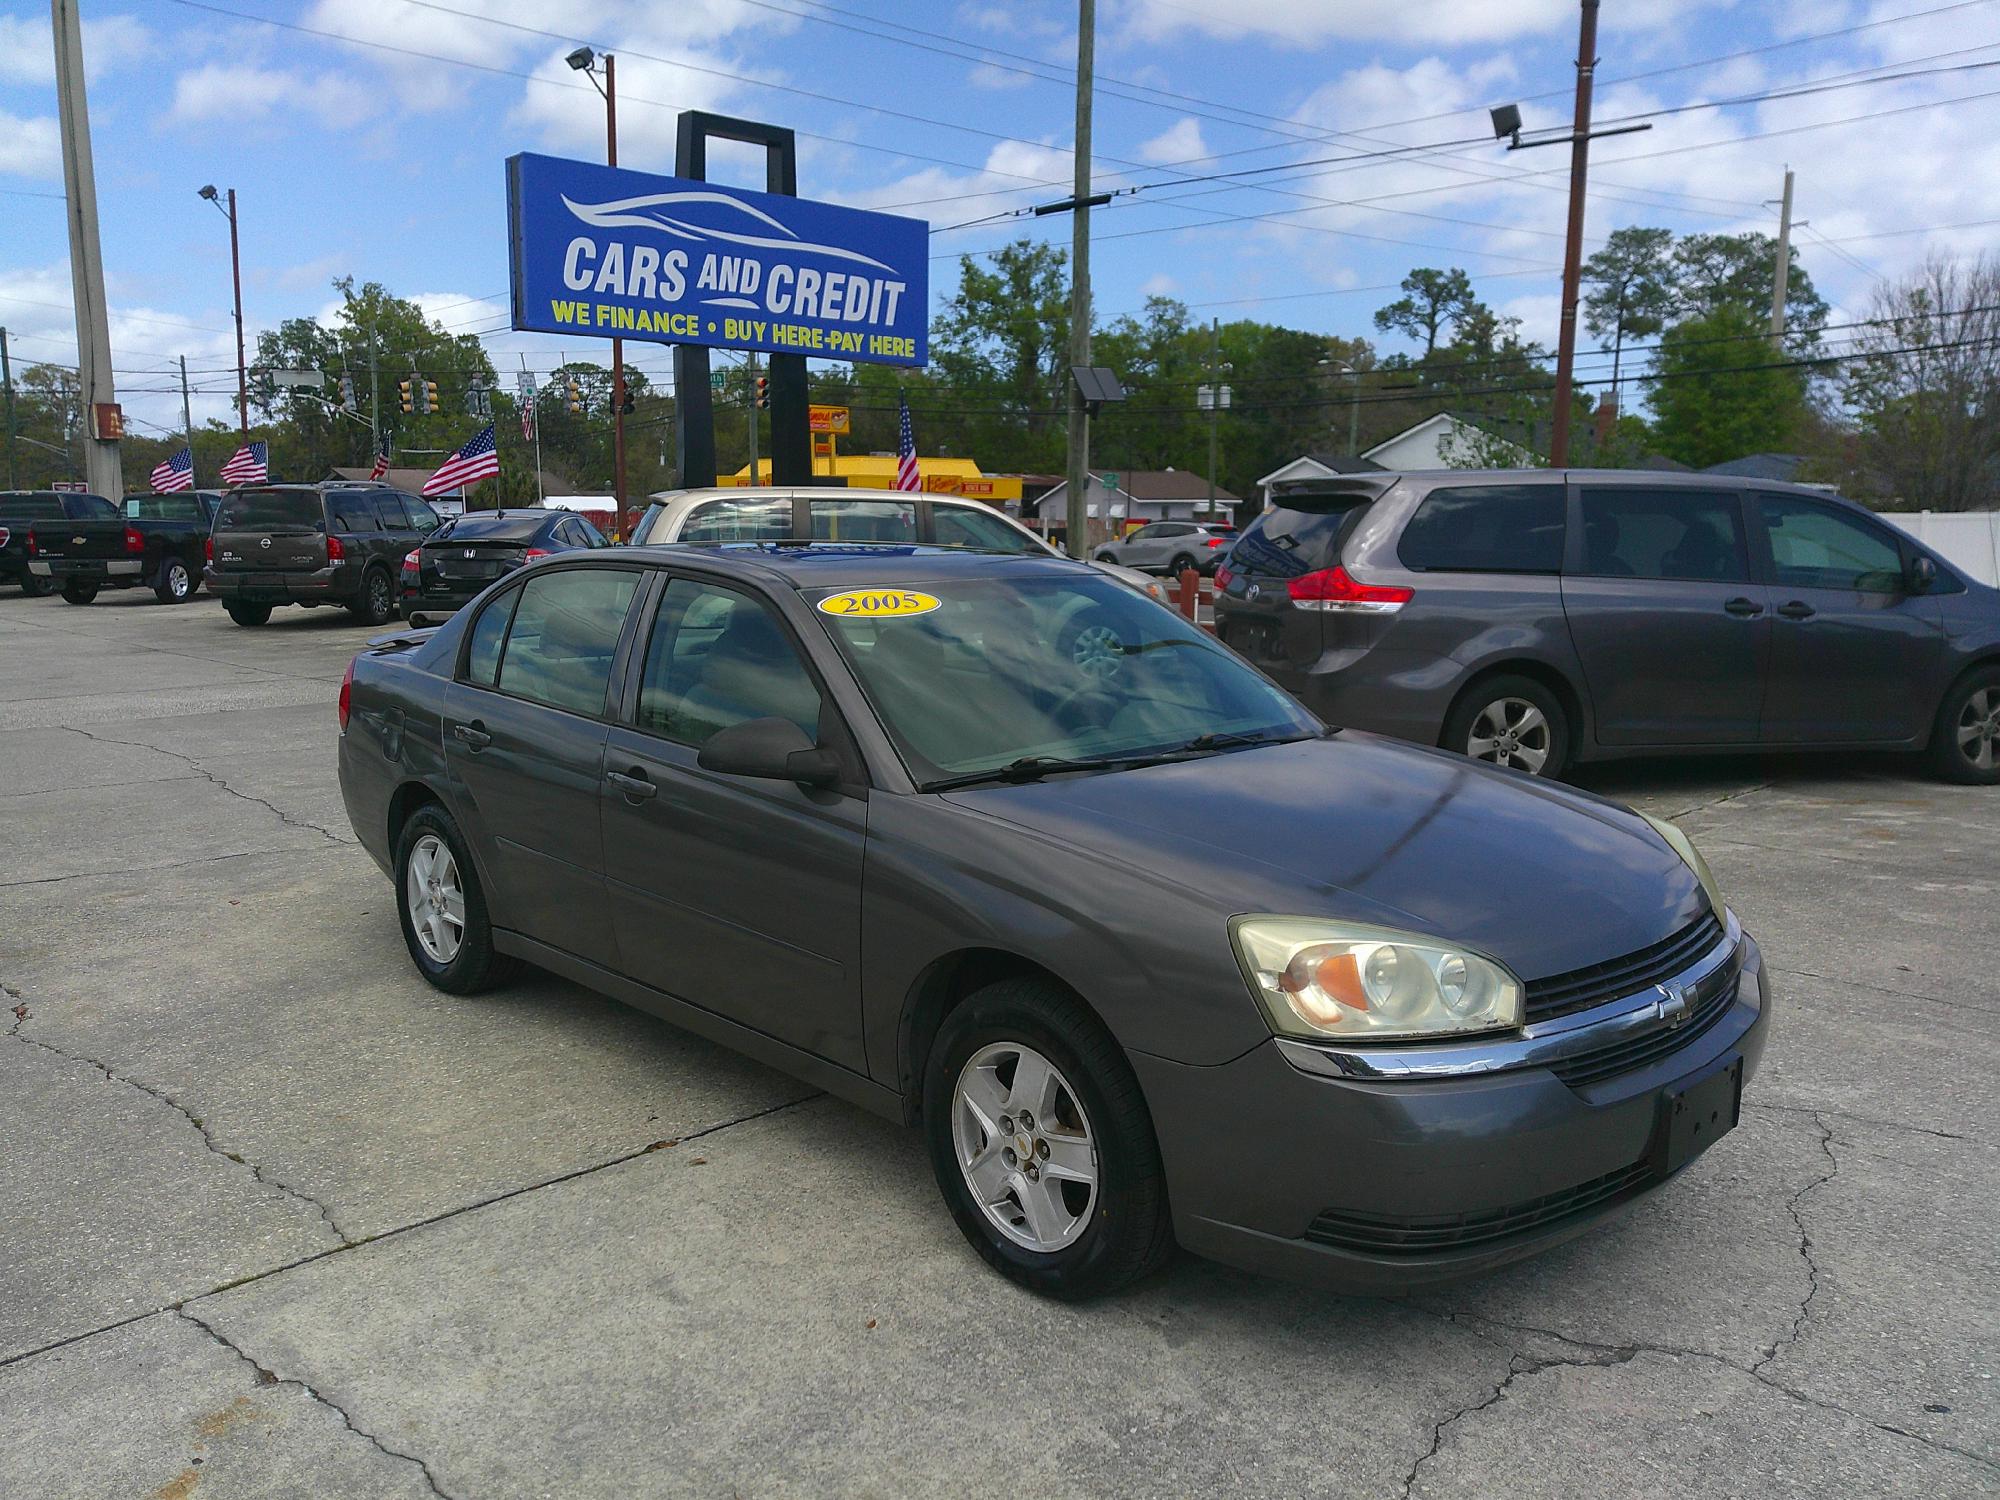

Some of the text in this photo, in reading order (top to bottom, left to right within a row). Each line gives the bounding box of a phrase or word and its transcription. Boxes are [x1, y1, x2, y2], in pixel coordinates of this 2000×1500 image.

[563, 237, 906, 326] CARS AND CREDIT
[552, 300, 590, 325] WE
[597, 304, 699, 336] FINANCE
[725, 318, 767, 342] BUY
[870, 335, 915, 358] HERE
[840, 593, 919, 613] 2005
